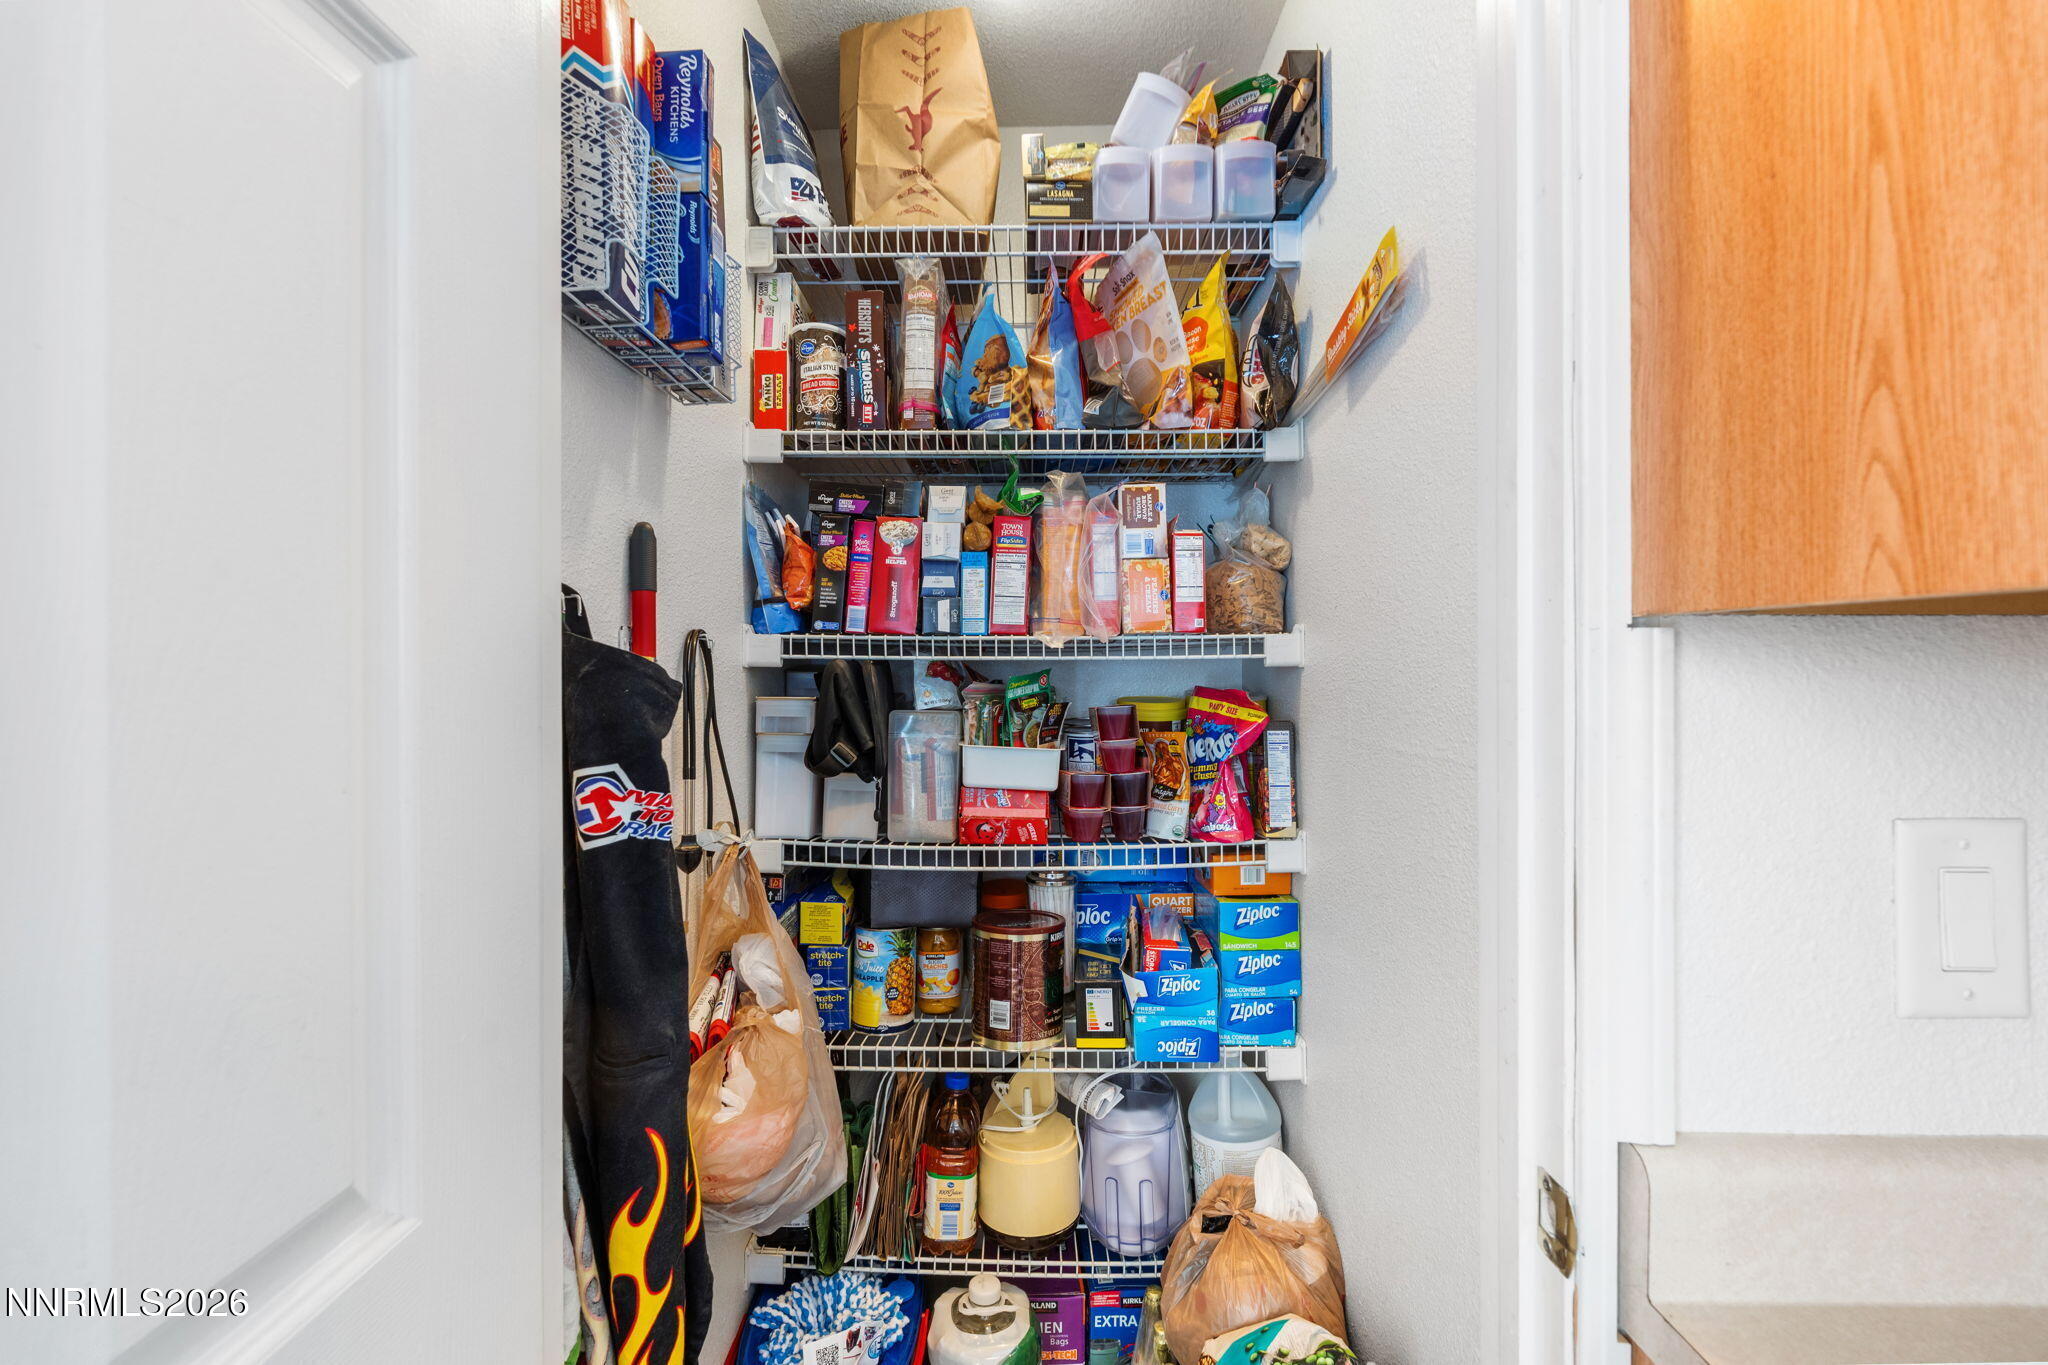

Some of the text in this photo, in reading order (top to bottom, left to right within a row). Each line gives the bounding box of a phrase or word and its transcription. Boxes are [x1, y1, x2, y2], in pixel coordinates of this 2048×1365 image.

[653, 57, 665, 122] Oven Bags
[678, 54, 698, 129] Reynolds
[669, 85, 679, 143] KITCHENS
[1247, 103, 1269, 114] BEEF
[1046, 189, 1074, 197] LASAGNA
[688, 200, 698, 235] Reynolds
[1129, 280, 1167, 320] BREAST
[857, 297, 872, 344] HERSHEY'S
[803, 363, 837, 373] ITALIAN STYLE
[860, 350, 874, 404] S'MORES
[802, 378, 838, 391] BREAD CRUMBS
[764, 376, 772, 408] PANKO
[863, 406, 873, 422] KIT
[817, 493, 834, 504] Kroger
[821, 520, 835, 528] Kroger
[1000, 537, 1024, 545] FlipSides
[889, 580, 898, 618] Stroganoff
[1208, 702, 1239, 716] PARTY SIZE
[1193, 770, 1218, 781] Cluste
[1167, 803, 1185, 814] Curry
[617, 821, 674, 840] RAC
[1151, 895, 1193, 907] QUART
[1076, 907, 1111, 929] ploc
[1236, 905, 1280, 926] Ziploc
[1050, 931, 1065, 942] KIRK
[857, 938, 875, 951] Dole
[810, 951, 845, 960] stretch-
[1148, 950, 1156, 972] STORA
[817, 959, 833, 967] tite
[862, 960, 885, 974] Juice
[1238, 954, 1281, 975] Ziploc
[1160, 975, 1201, 997] Ziploc
[815, 993, 845, 1003] tretch-
[818, 1001, 834, 1010] tite
[1230, 1002, 1274, 1021] Ziploc
[1159, 1019, 1197, 1027] CONGELAR
[1157, 1039, 1197, 1057] Ziploc
[1030, 1302, 1057, 1310] KLAND
[1122, 1297, 1144, 1305] KIRKL
[1094, 1315, 1138, 1328] EXTRA
[1049, 1337, 1069, 1347] Bags
[1041, 1348, 1078, 1361] EX-TECH
